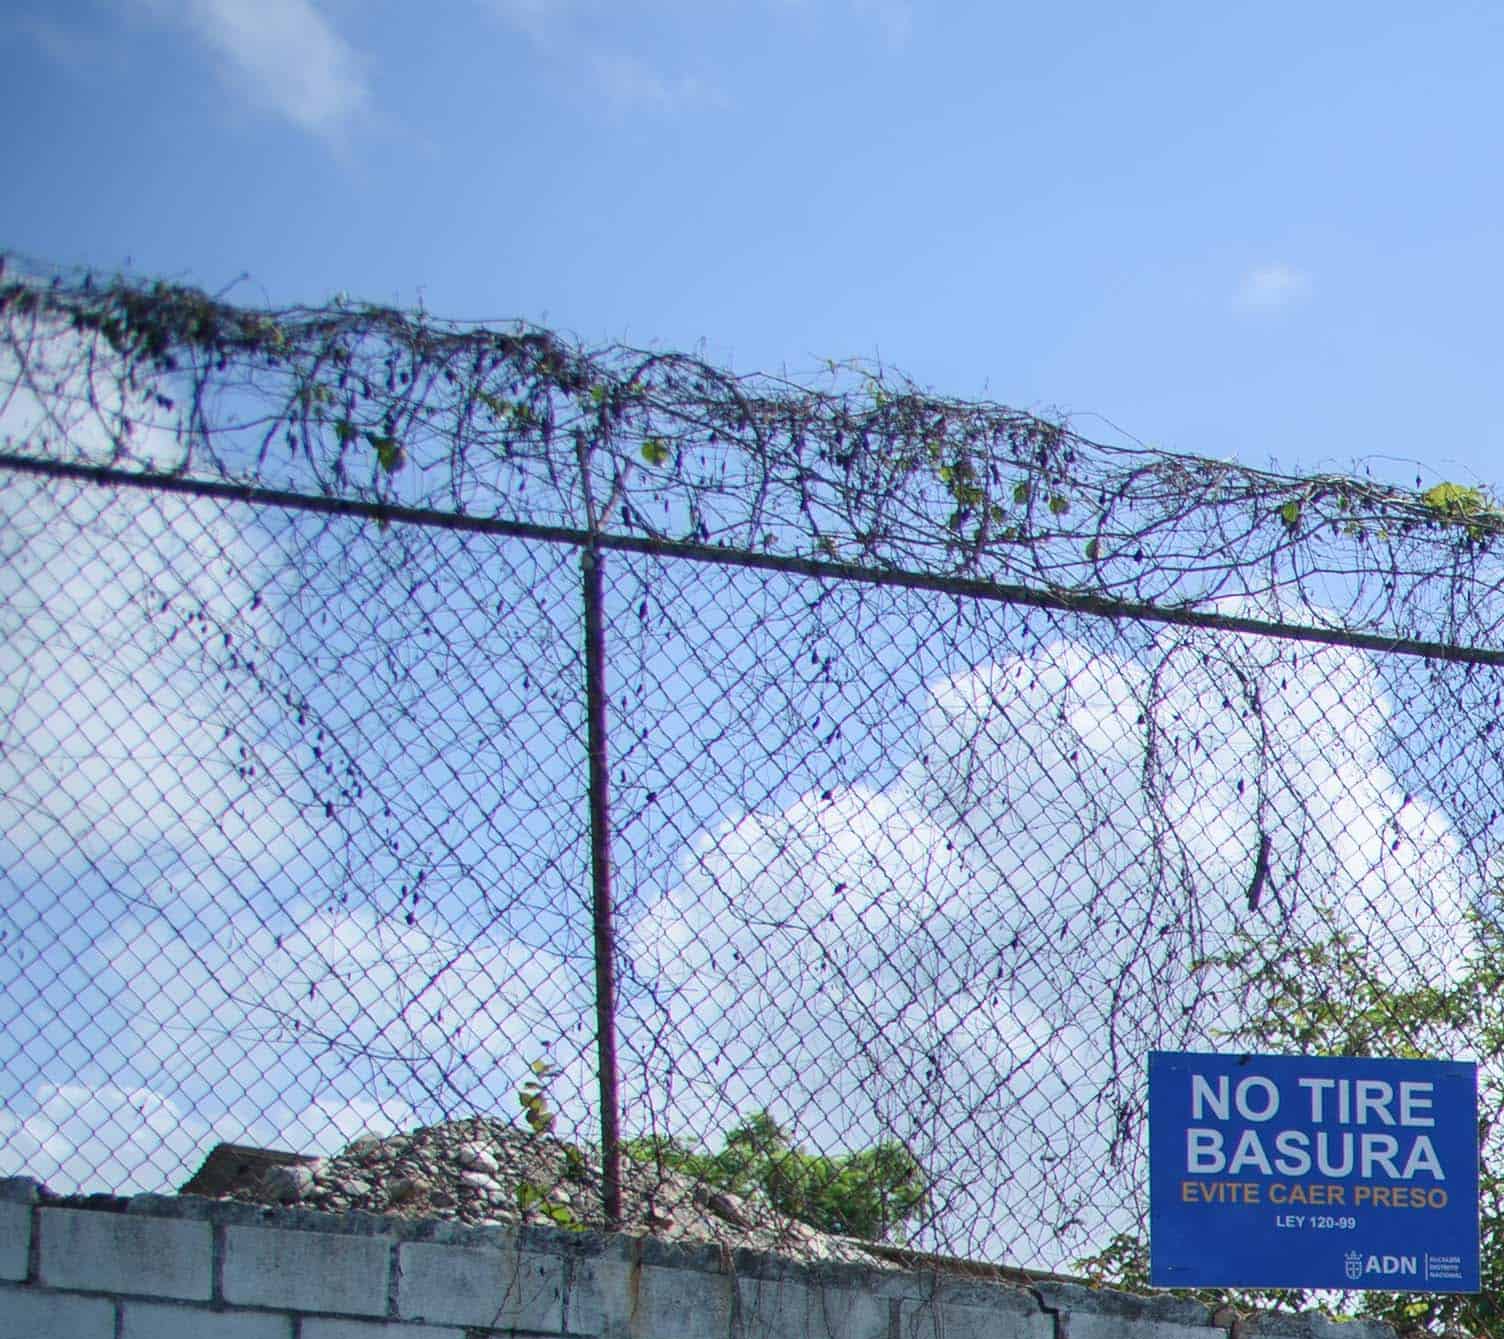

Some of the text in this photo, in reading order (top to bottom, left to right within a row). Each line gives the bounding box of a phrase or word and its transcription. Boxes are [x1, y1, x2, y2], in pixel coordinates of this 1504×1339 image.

[1191, 1075, 1435, 1127] NO TIRE
[1186, 1128, 1446, 1181] BASURA
[1181, 1181, 1449, 1209] EVITE CAER PRESO
[1276, 1215, 1356, 1229] LEY 120-99
[1365, 1256, 1417, 1275] ADN
